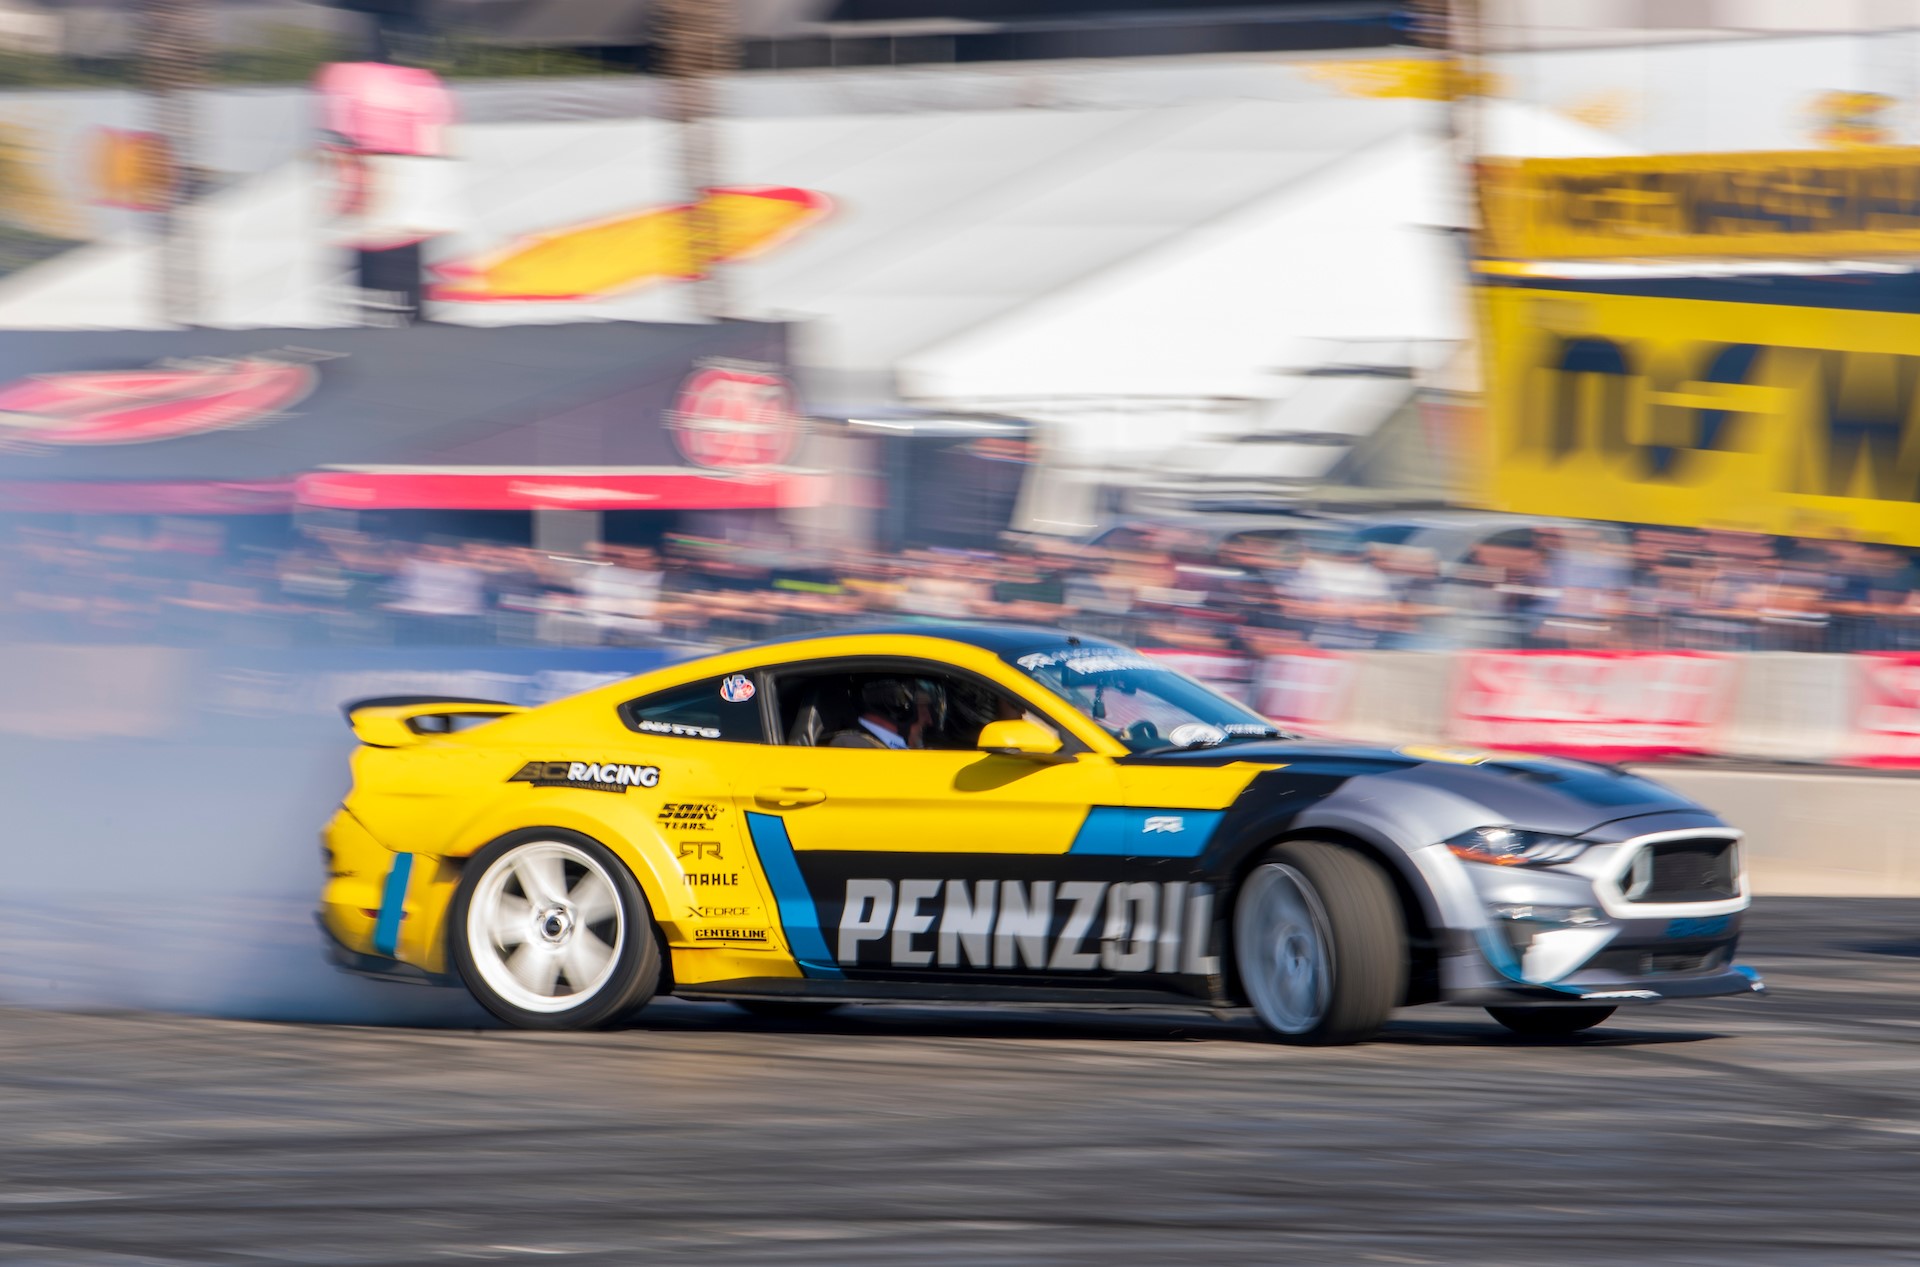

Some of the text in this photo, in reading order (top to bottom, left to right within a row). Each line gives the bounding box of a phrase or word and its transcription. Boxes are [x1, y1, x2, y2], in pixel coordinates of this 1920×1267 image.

[683, 873, 738, 885] MAHLE
[837, 878, 1221, 976] PENNZOIL
[695, 929, 766, 938] CENTER LINE
